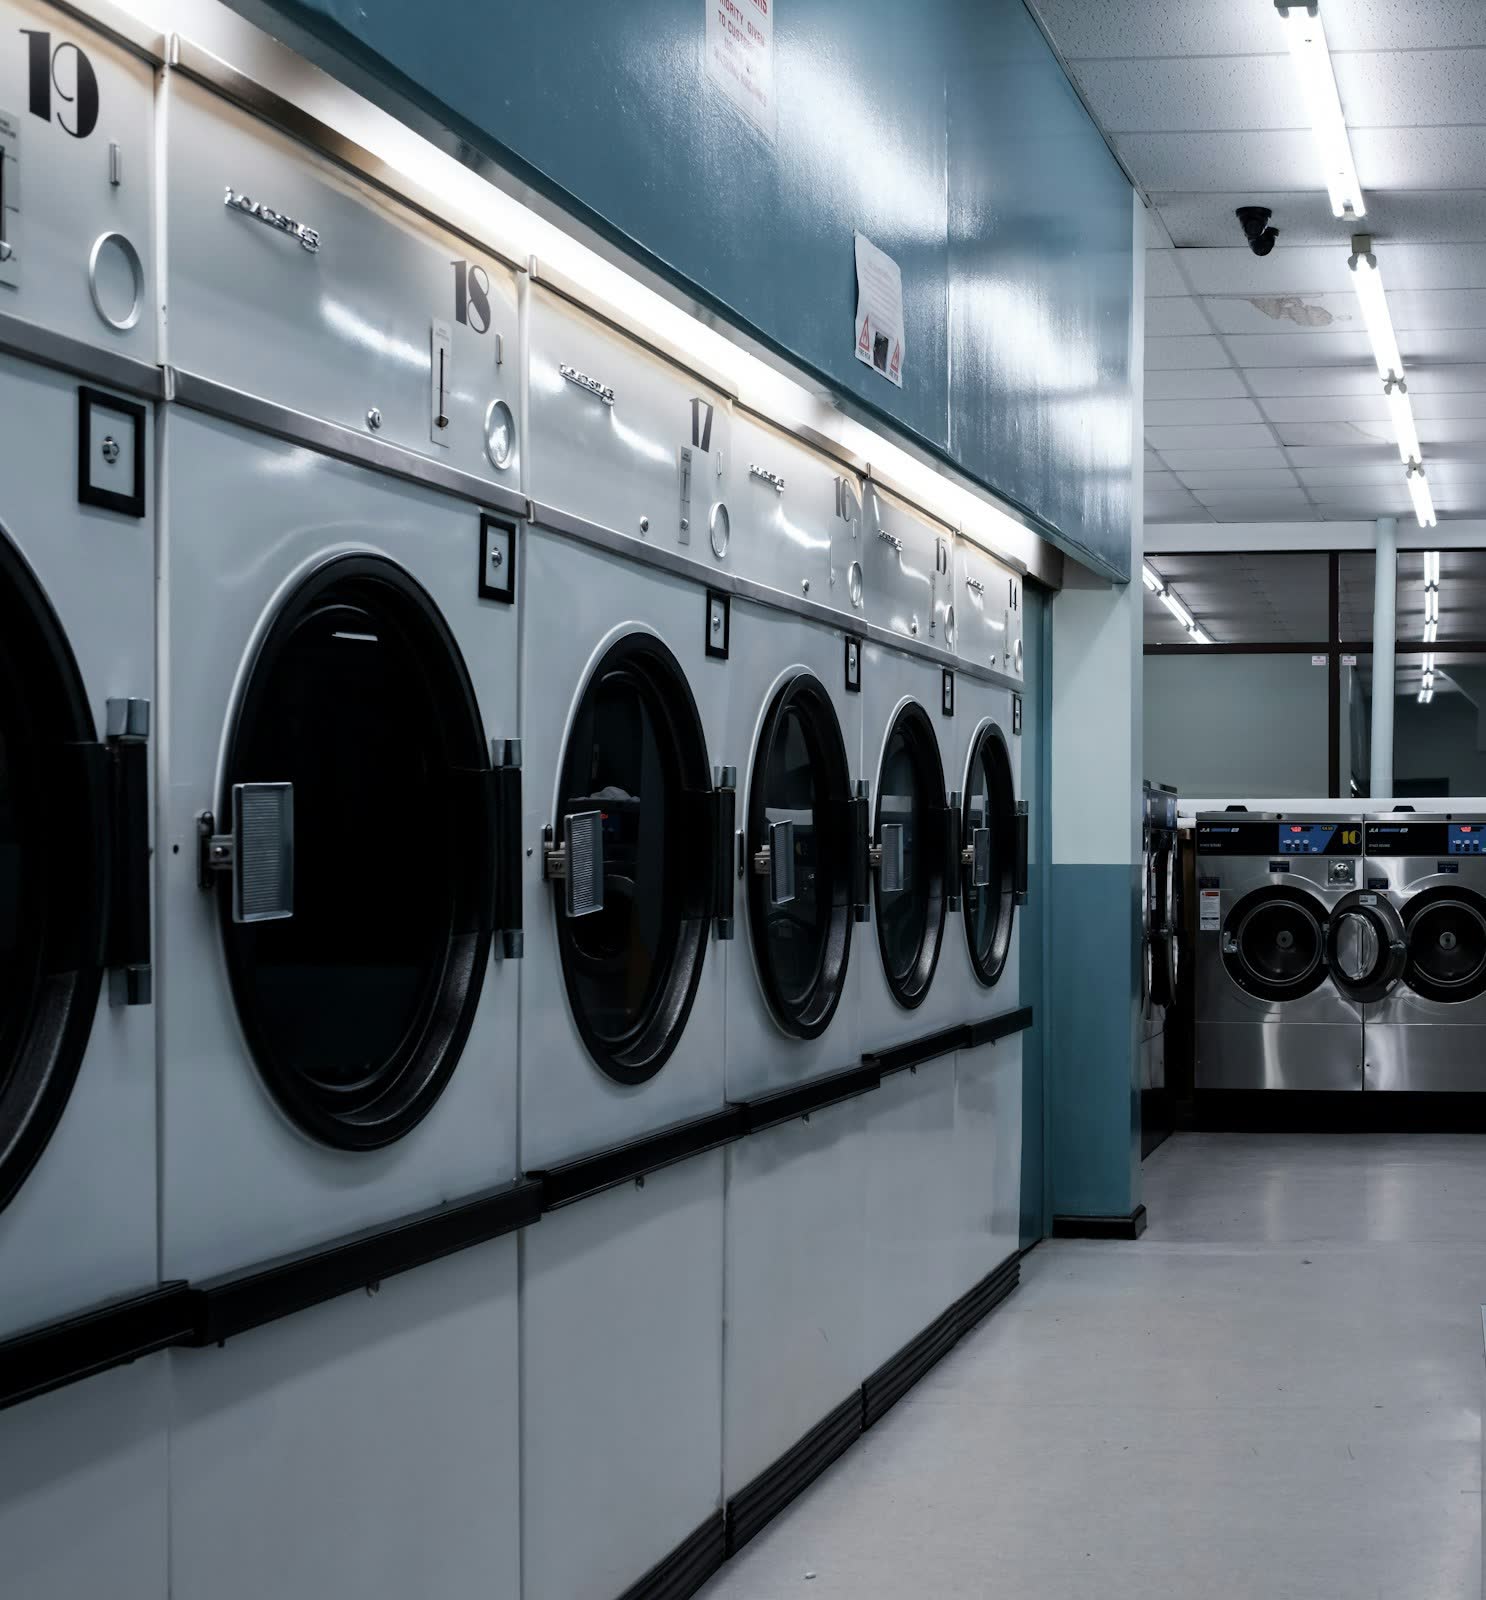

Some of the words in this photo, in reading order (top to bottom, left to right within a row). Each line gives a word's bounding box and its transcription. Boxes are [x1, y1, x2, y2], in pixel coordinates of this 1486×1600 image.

[718, 9, 725, 27] TO
[19, 29, 99, 139] 19
[450, 260, 492, 334] 18
[689, 398, 713, 453] 17
[1008, 578, 1018, 611] 14
[1341, 830, 1362, 845] 10
